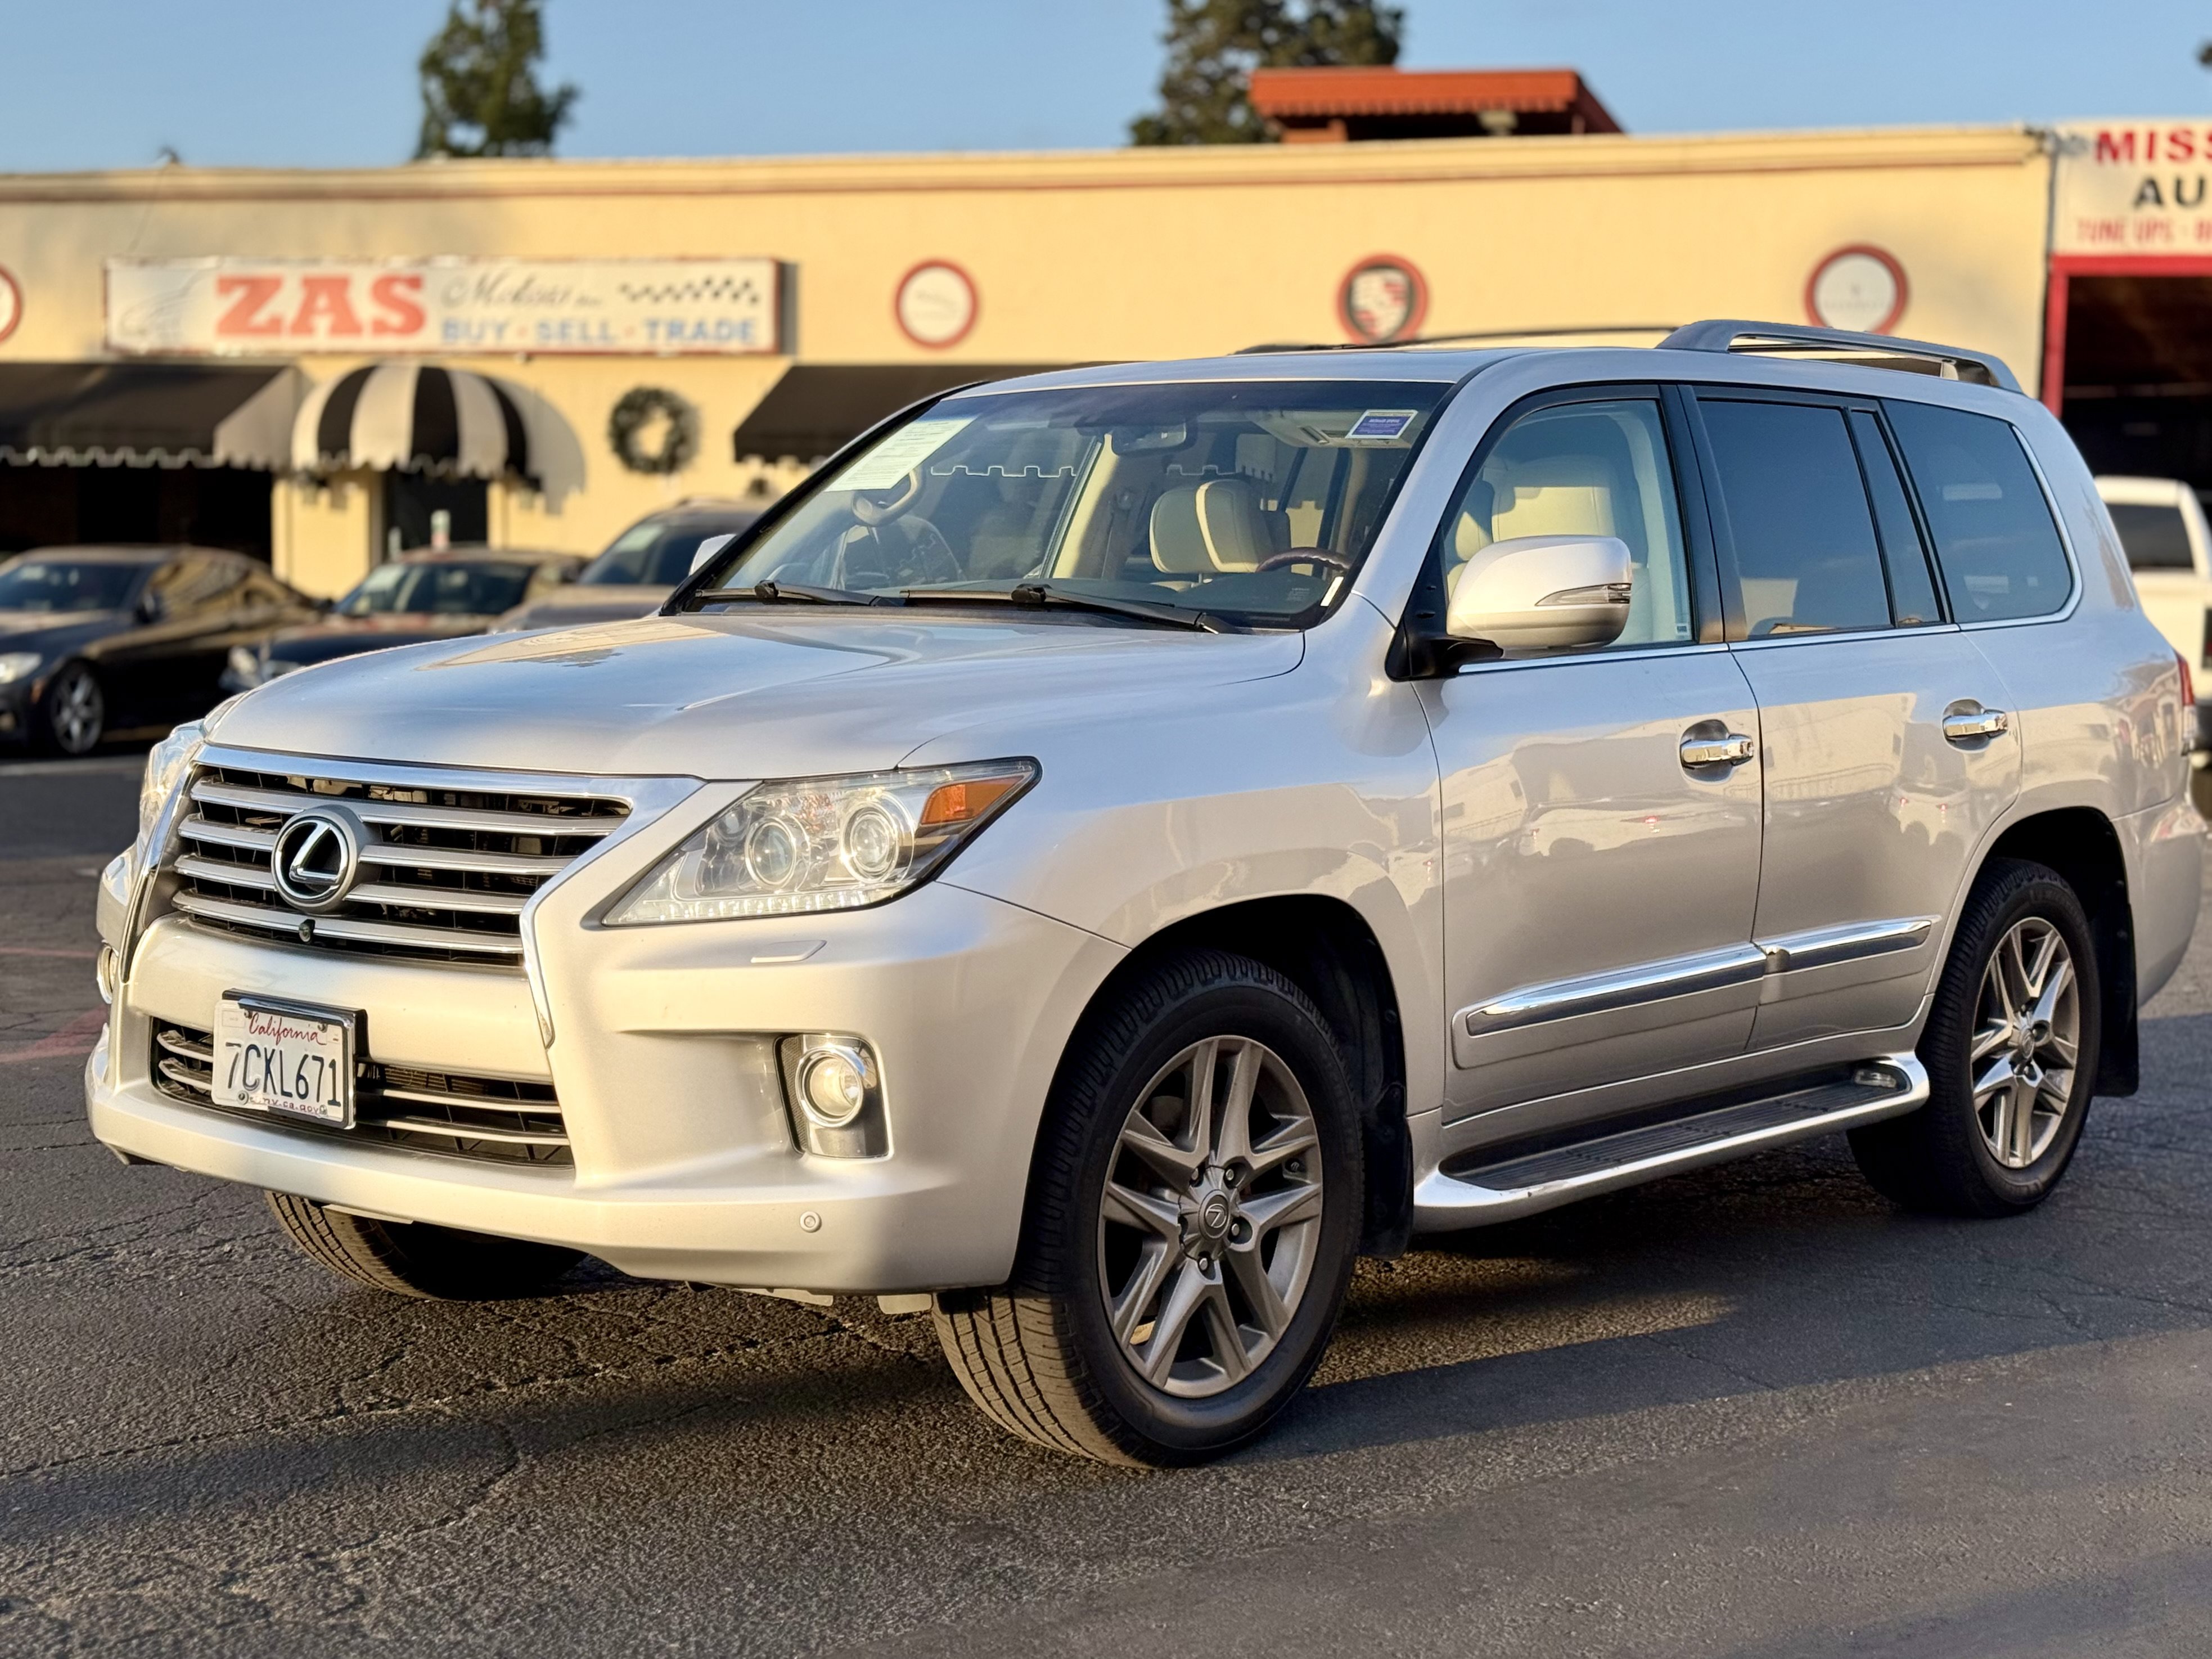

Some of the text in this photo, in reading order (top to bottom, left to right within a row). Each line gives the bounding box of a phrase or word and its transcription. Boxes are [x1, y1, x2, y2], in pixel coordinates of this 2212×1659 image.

[2096, 129, 2212, 164] MIS
[215, 273, 426, 336] ZAS
[442, 317, 757, 345] BUY SELL TRADE
[249, 1013, 327, 1045] California
[226, 1042, 341, 1107] 7CKL671
